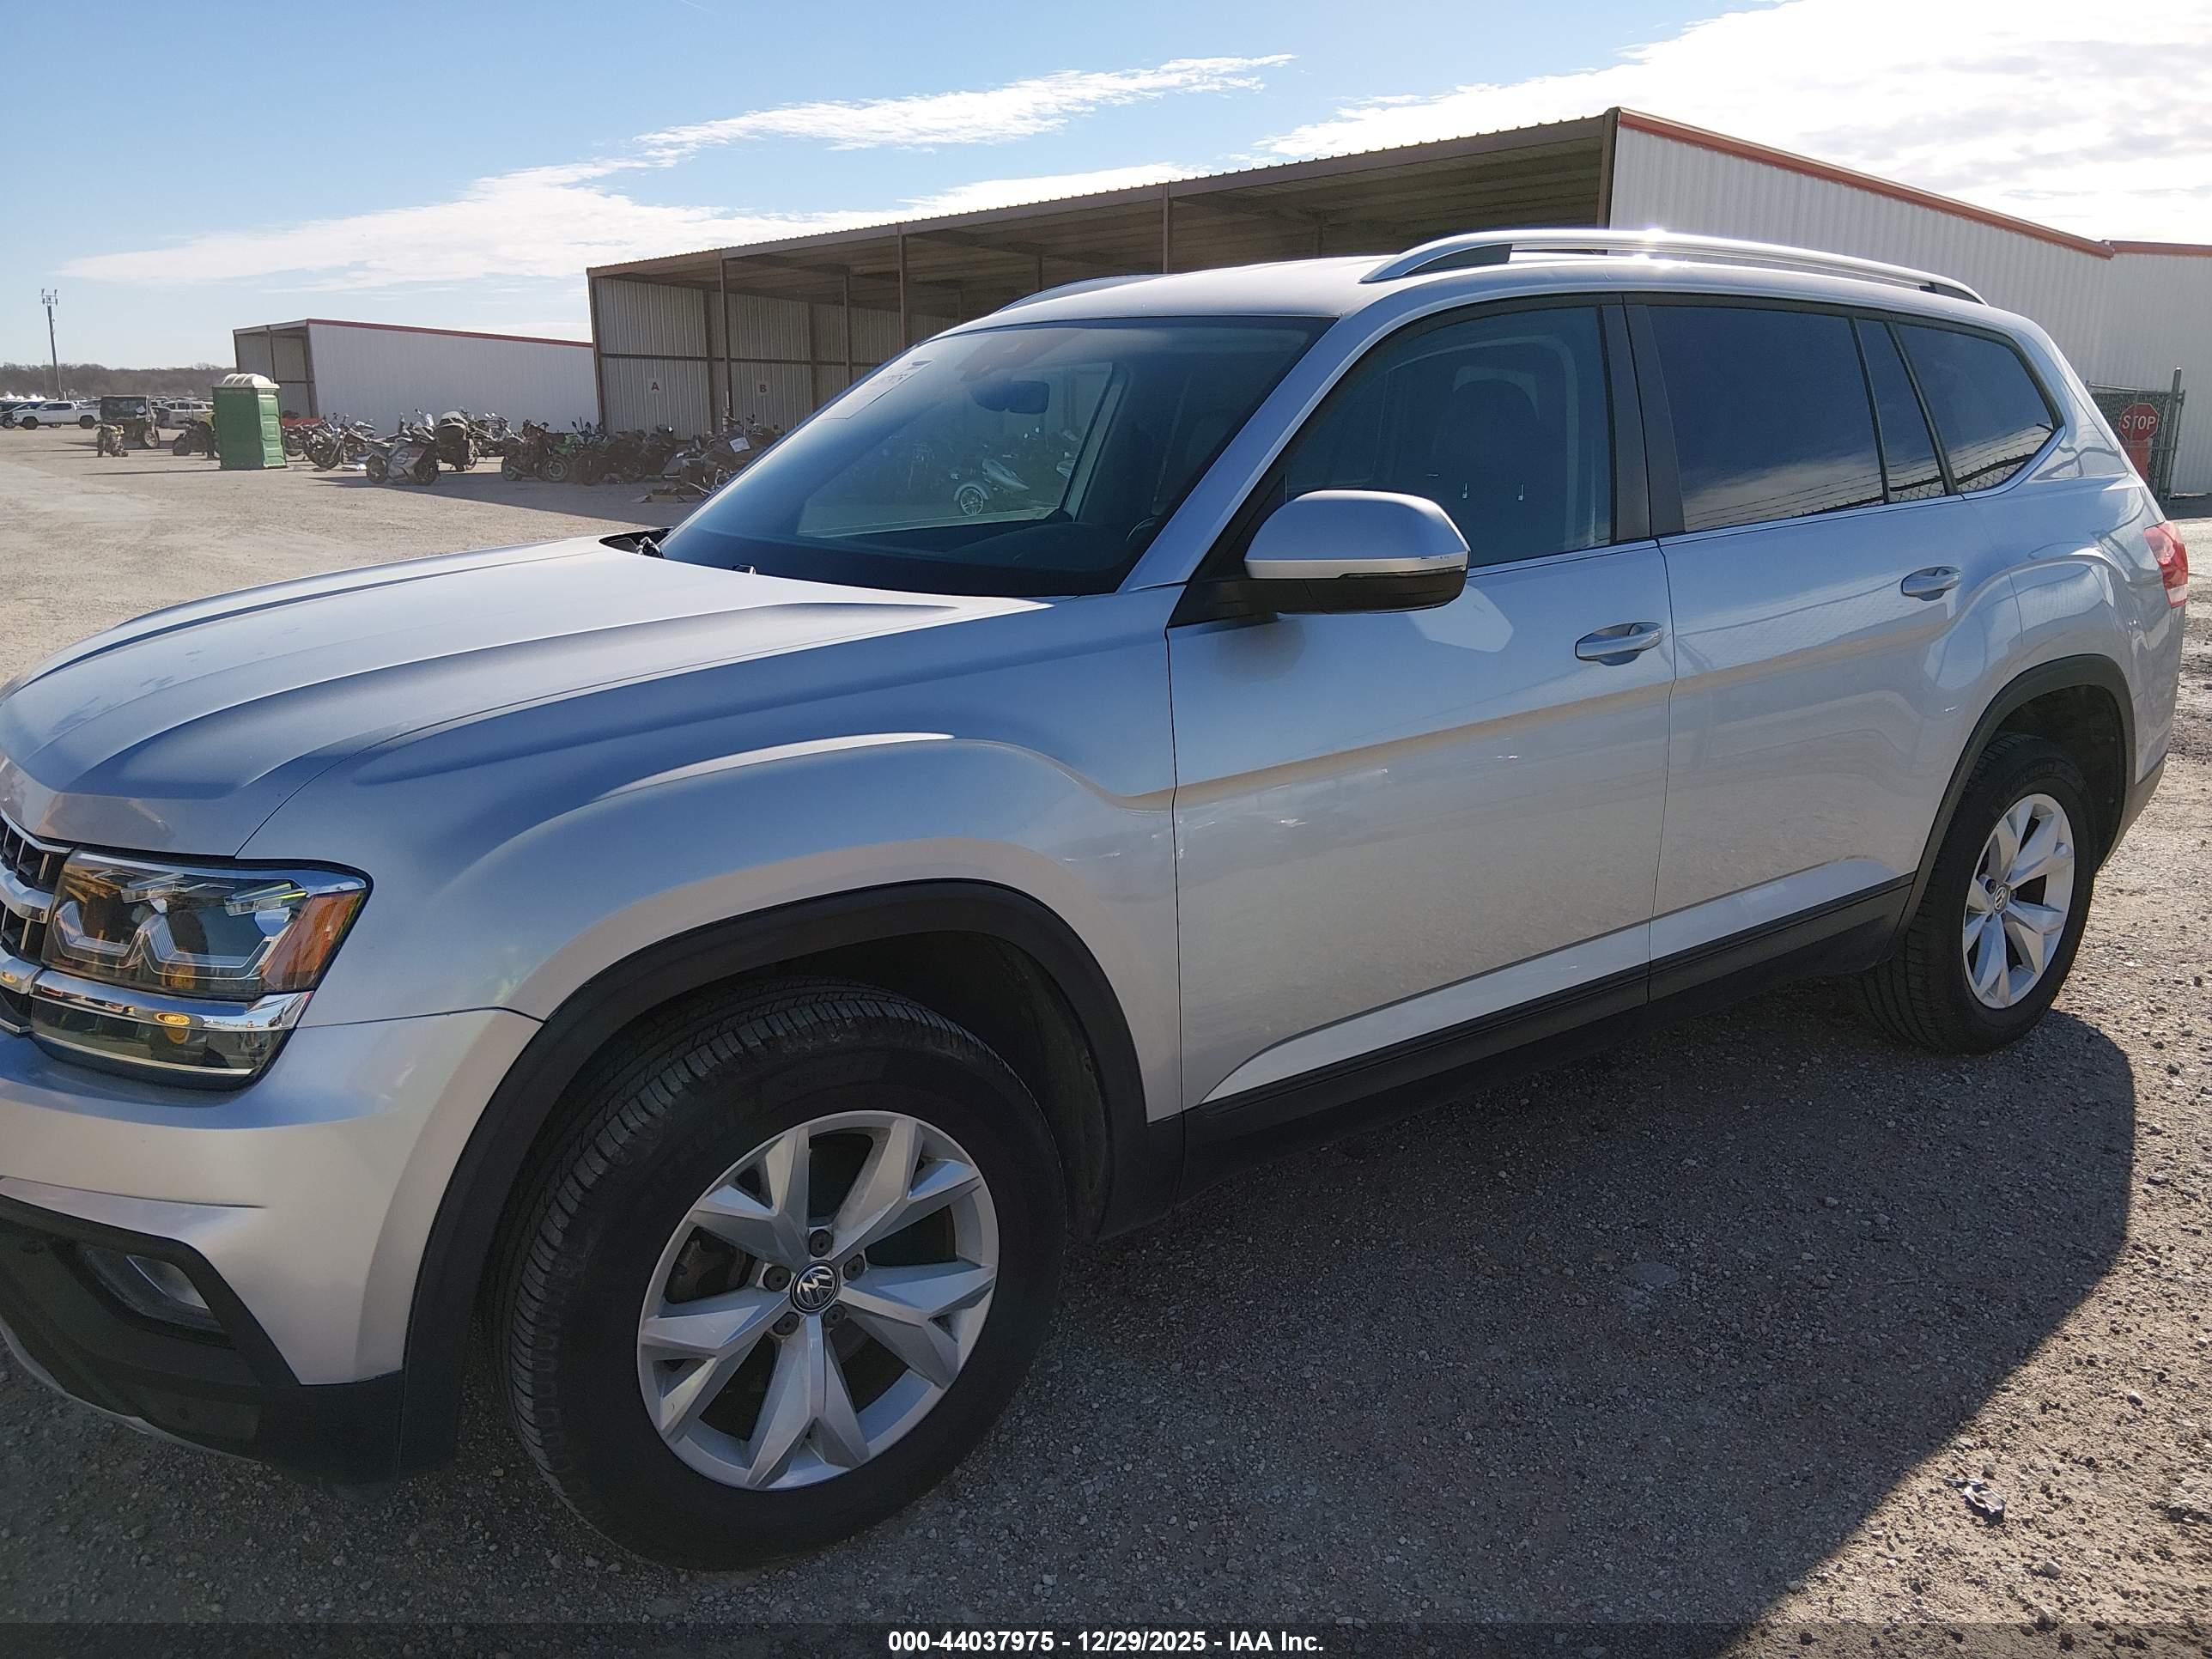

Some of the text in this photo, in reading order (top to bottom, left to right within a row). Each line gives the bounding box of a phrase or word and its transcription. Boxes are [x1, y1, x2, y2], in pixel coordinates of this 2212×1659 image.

[651, 381, 660, 392] A
[759, 384, 767, 393] B
[2122, 415, 2156, 430] STOP
